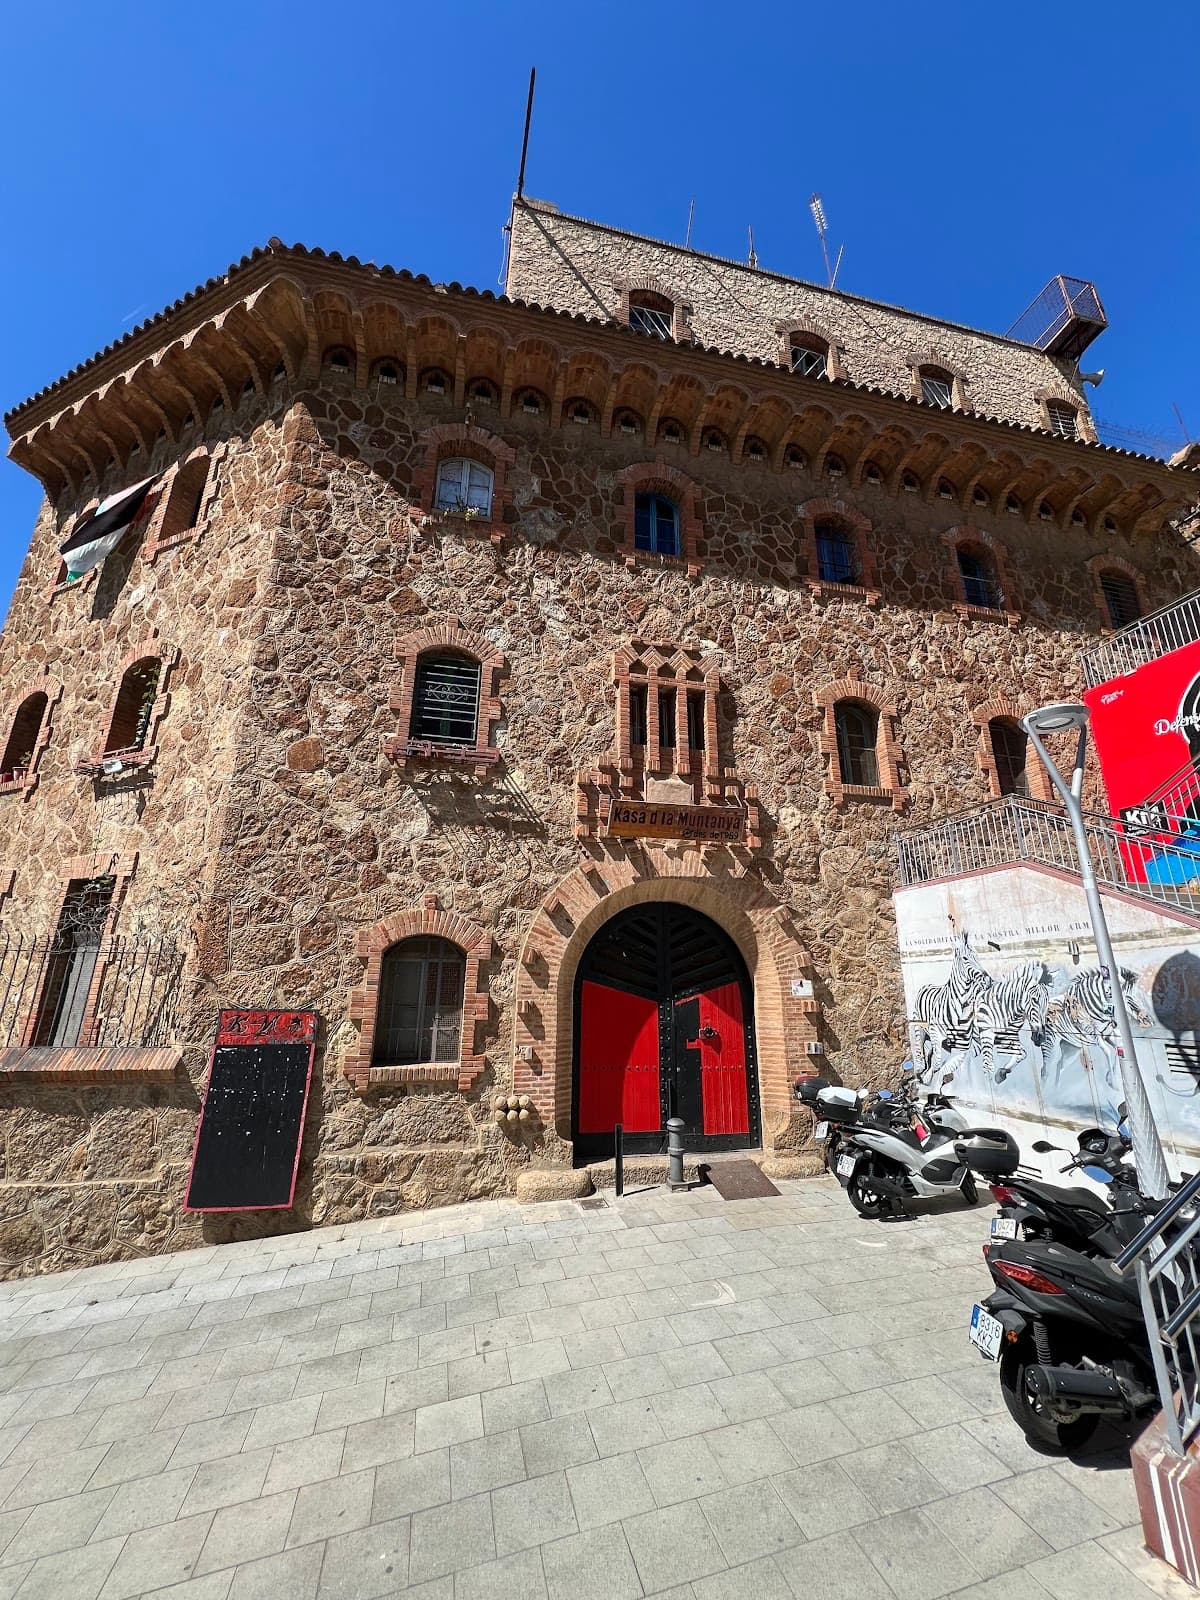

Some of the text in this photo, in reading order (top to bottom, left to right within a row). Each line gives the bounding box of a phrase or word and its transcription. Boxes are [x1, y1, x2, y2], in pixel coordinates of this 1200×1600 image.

[1154, 712, 1200, 736] Defens
[614, 807, 646, 824] Kasa
[661, 811, 674, 826] la
[677, 812, 740, 831] Muntanya
[1025, 924, 1060, 935] MILLOR
[1069, 921, 1090, 931] ARM
